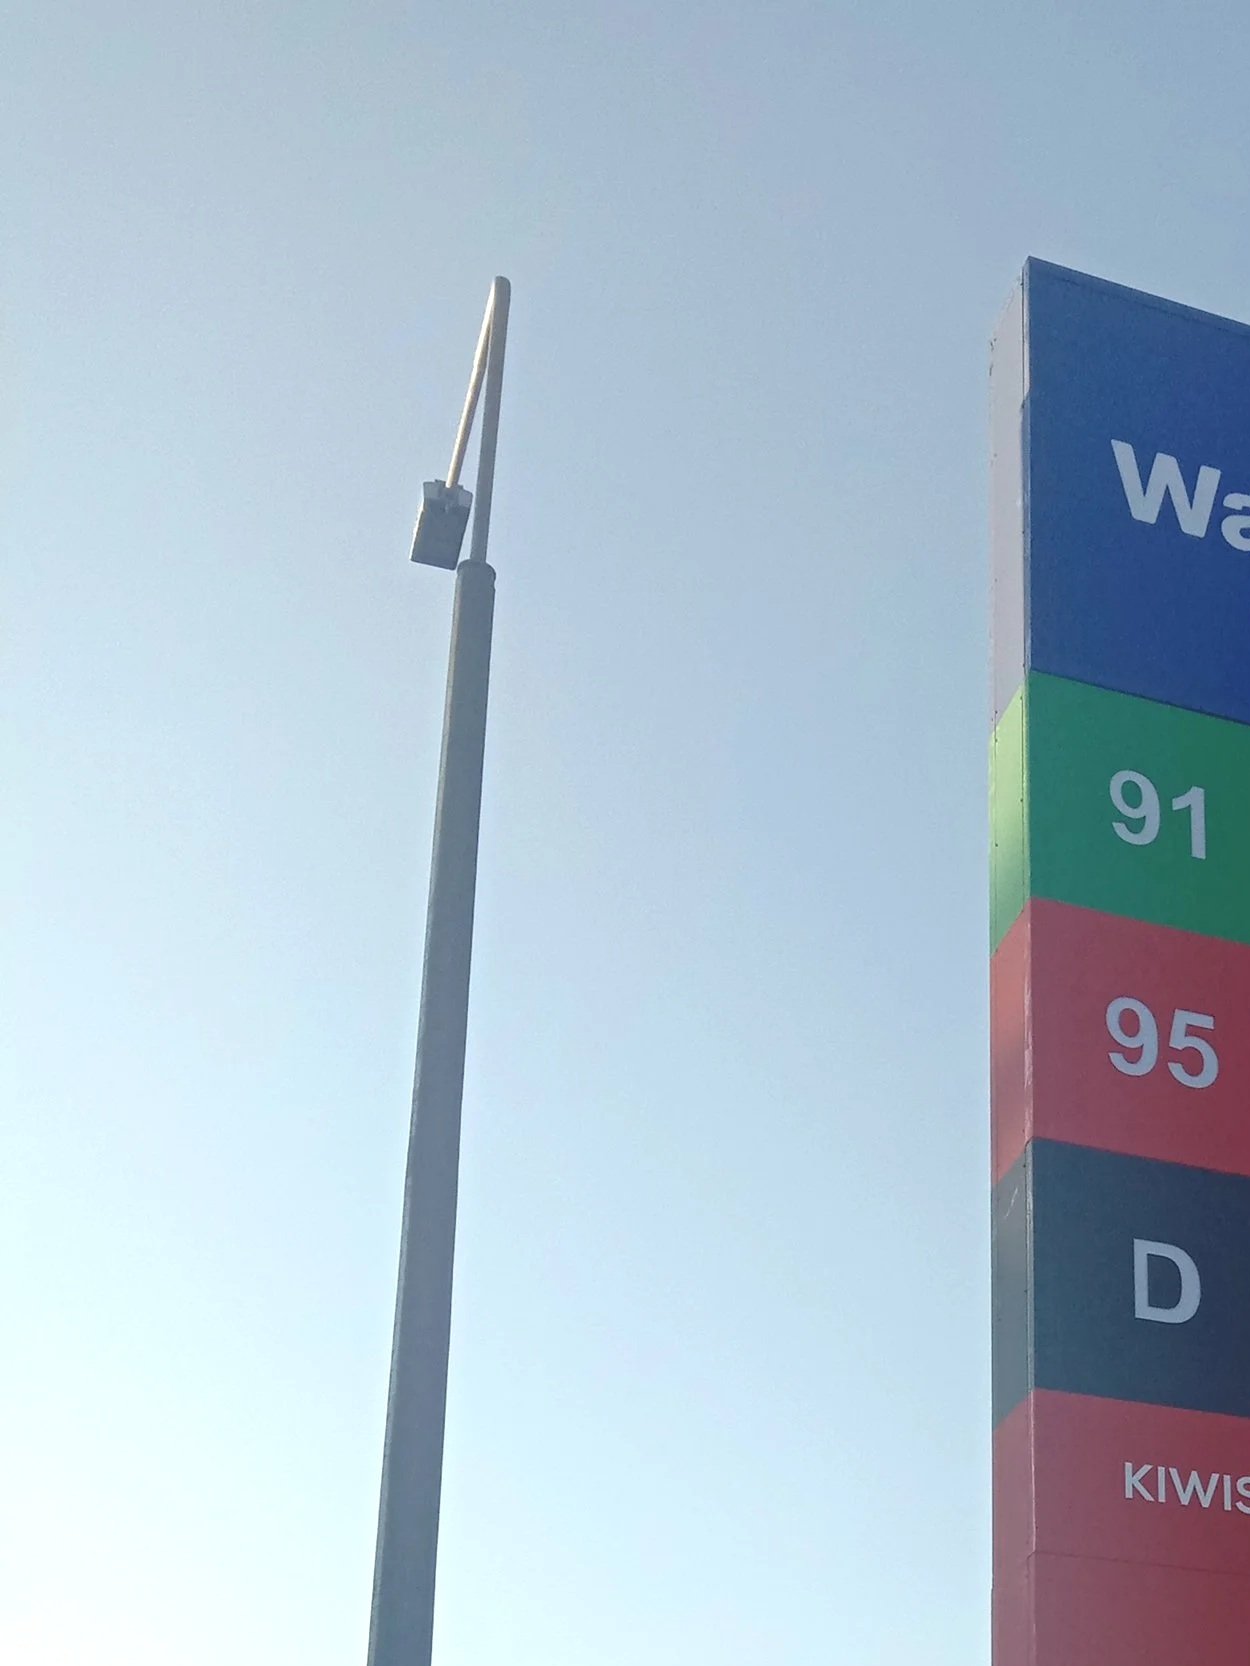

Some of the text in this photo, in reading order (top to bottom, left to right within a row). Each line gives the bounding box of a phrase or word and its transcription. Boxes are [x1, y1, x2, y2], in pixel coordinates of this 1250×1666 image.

[1109, 769, 1207, 860] 91
[1105, 996, 1219, 1089] 95
[1133, 1238, 1201, 1324] D
